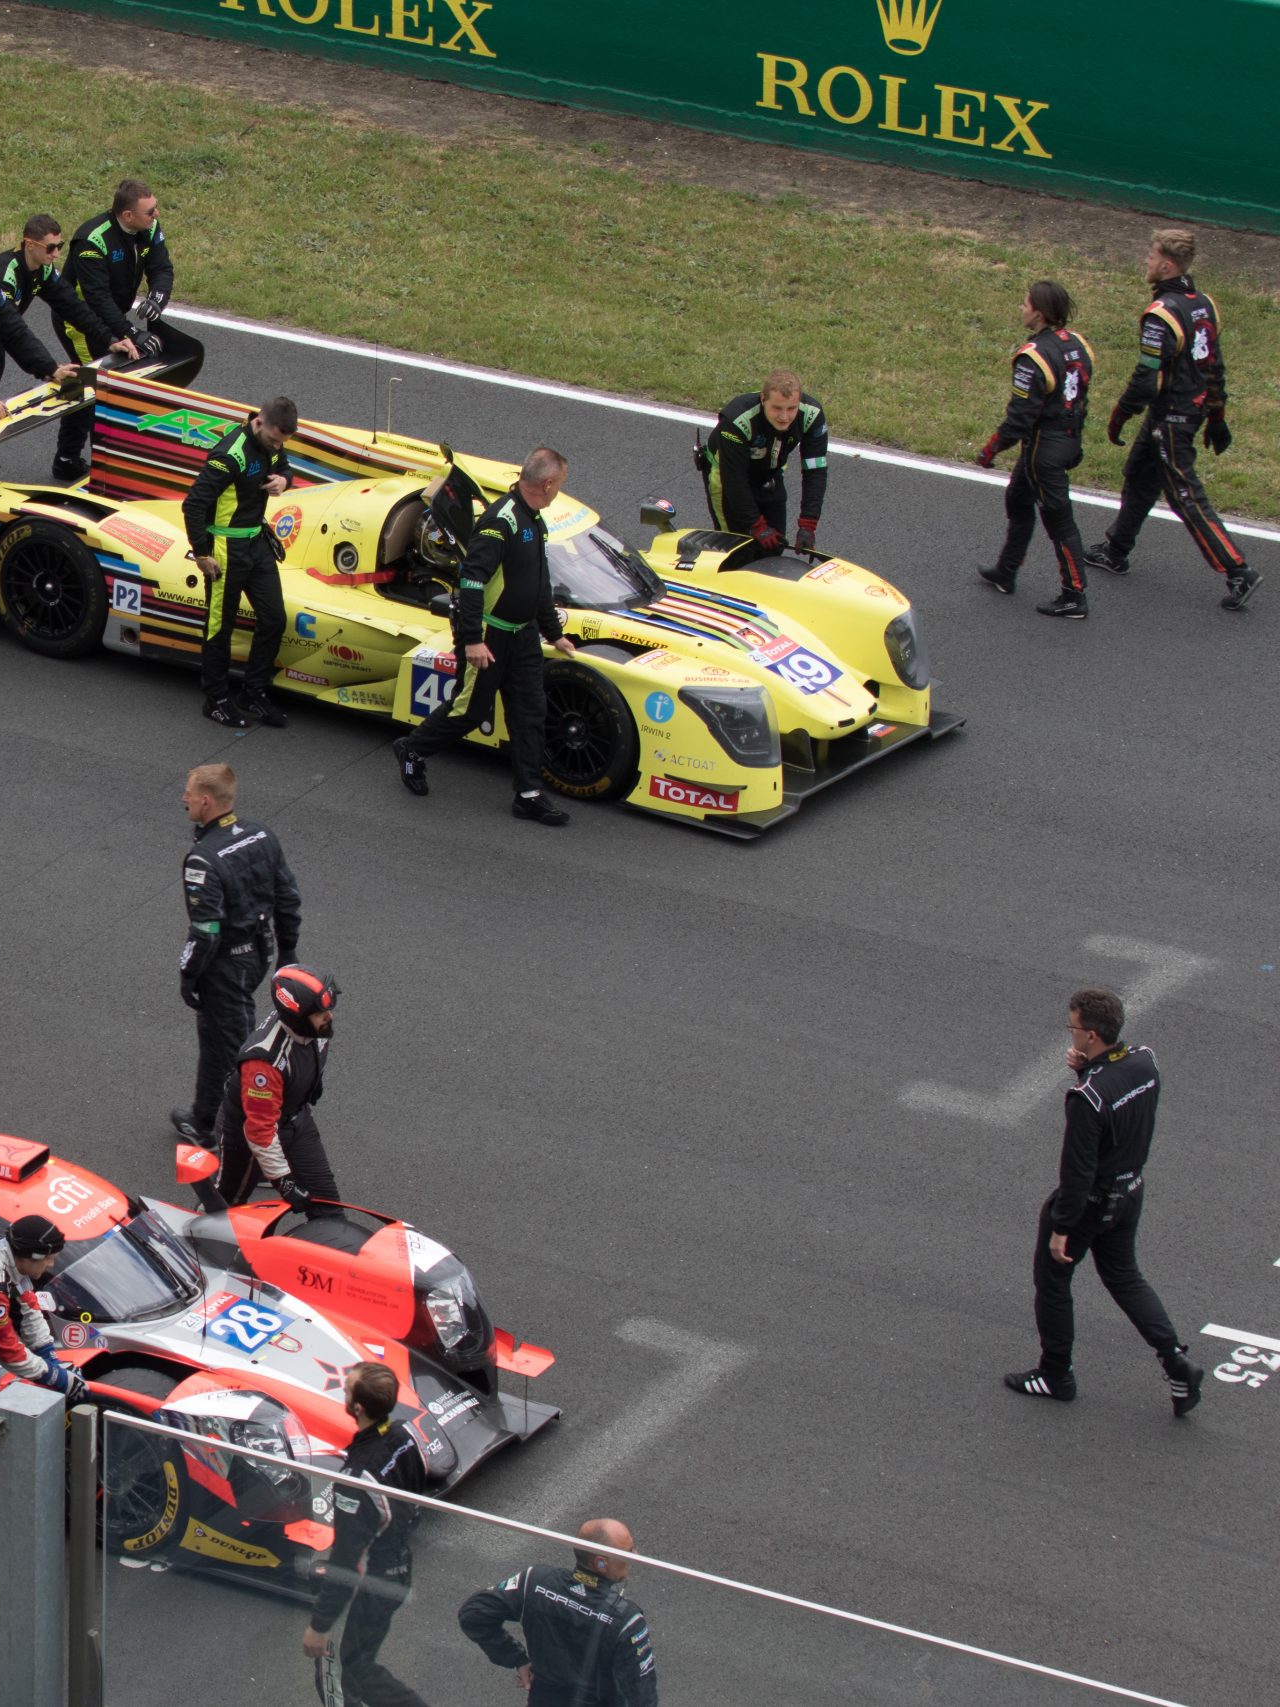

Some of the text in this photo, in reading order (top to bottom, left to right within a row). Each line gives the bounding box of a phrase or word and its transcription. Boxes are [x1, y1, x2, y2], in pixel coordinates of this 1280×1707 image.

[217, 0, 497, 58] LEX
[756, 52, 1053, 160] ROLEX
[407, 470, 433, 481] ONDRE
[811, 563, 837, 579] MOTUL
[116, 585, 138, 611] P2
[158, 590, 209, 608] www.arc
[620, 633, 668, 650] DUNLOP
[764, 640, 795, 657] TOTAL
[438, 655, 458, 669] TOT
[776, 653, 833, 692] 49
[286, 671, 328, 685] MOTUL
[685, 676, 727, 684] BUSINESS
[351, 690, 386, 701] ARIEL
[670, 753, 717, 771] ACTOAT
[654, 778, 734, 810] TOTAL
[217, 830, 267, 859] PORSCHE
[1112, 1078, 1157, 1112] PORSCHE
[47, 1174, 94, 1215] citi
[73, 1196, 119, 1230] Private Bank
[200, 1293, 233, 1315] TOTAL
[68, 1328, 81, 1343] E
[210, 1303, 283, 1349] 28
[98, 1338, 106, 1348] N
[133, 1484, 178, 1550] DUNLOP
[209, 1536, 268, 1561] DUNLOP
[535, 1585, 613, 1625] PORSCHE
